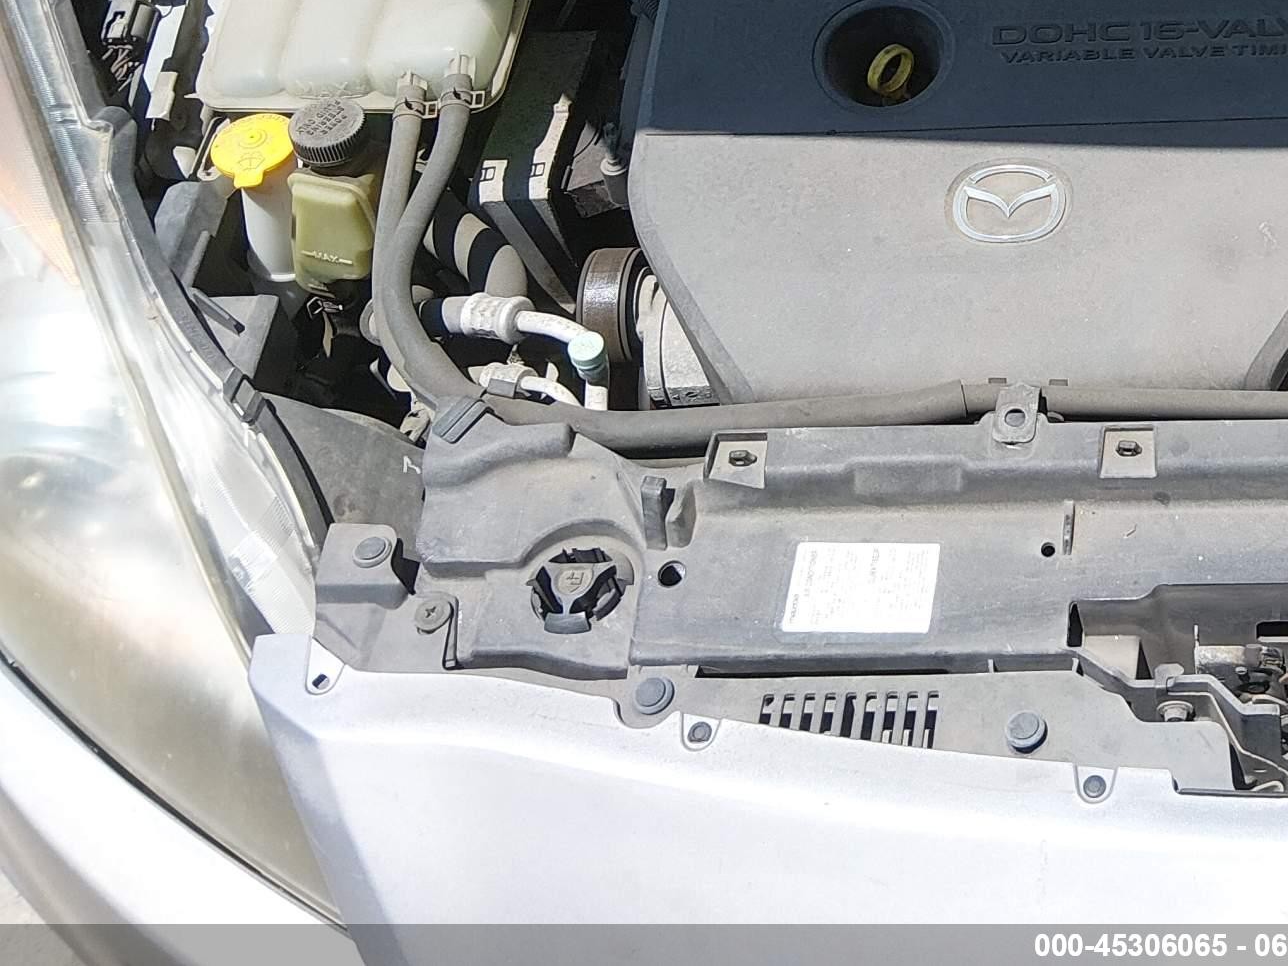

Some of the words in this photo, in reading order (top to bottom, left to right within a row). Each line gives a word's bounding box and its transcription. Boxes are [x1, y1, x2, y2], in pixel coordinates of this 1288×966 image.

[993, 21, 1132, 46] DOHC
[1002, 47, 1136, 65] VARIABLE
[1143, 45, 1226, 61] VALVE
[315, 100, 341, 118] FLUID
[305, 105, 344, 135] STEERING
[319, 113, 347, 133] POWER
